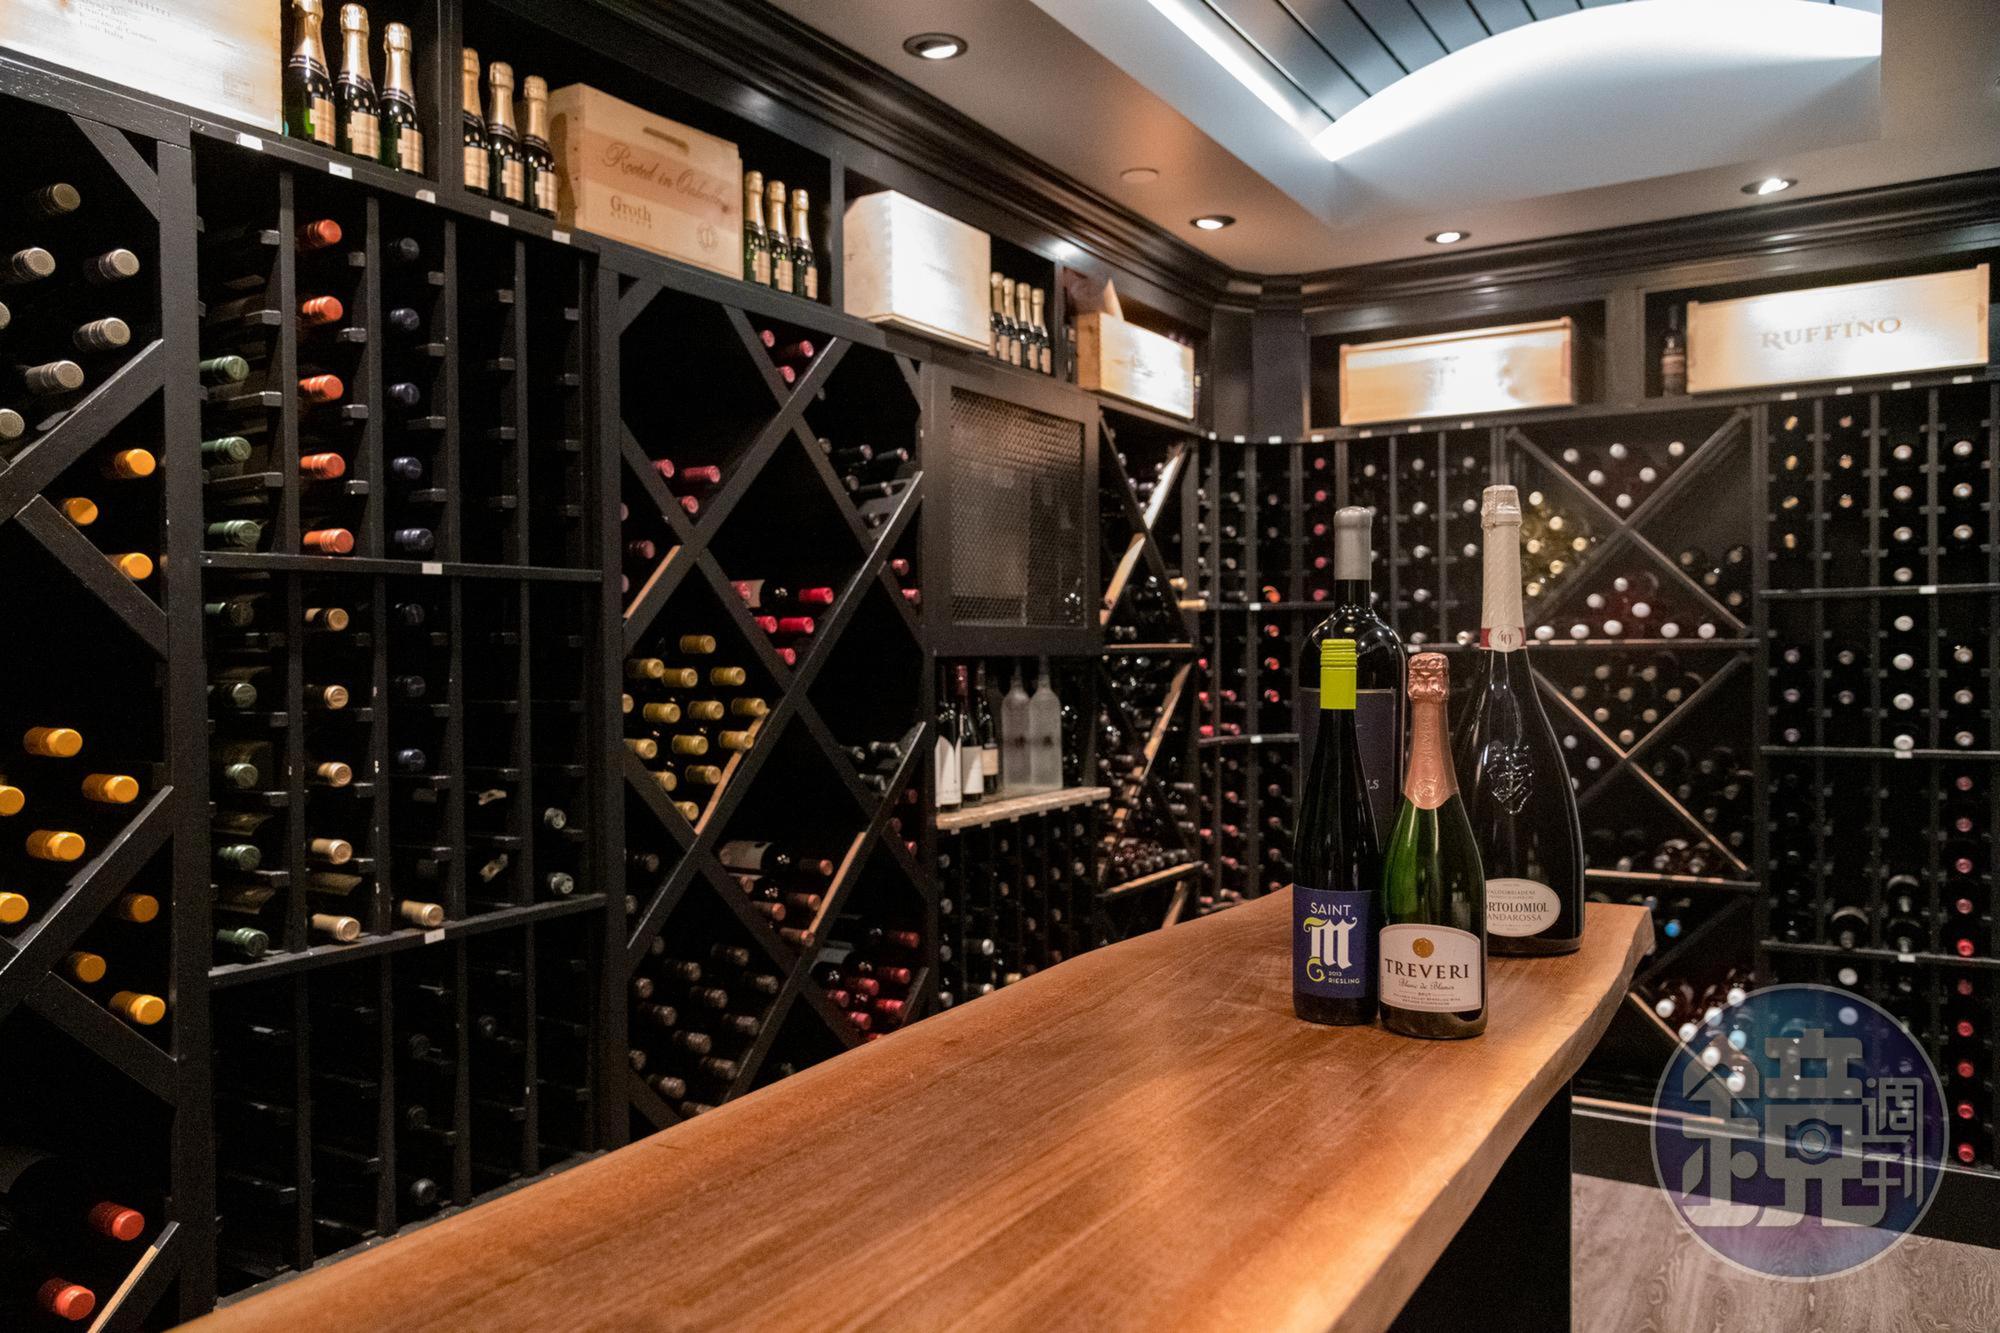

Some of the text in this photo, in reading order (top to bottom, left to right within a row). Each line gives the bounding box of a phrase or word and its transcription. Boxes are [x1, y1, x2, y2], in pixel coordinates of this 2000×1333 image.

[610, 195, 651, 222] Groth
[1760, 315, 1902, 350] RUFFINO
[1310, 902, 1351, 916] SAINT
[1487, 902, 1549, 913] RTOLOMIOL
[1487, 913, 1542, 921] ANDAROSSA
[1385, 958, 1469, 979] TREVERI
[1398, 978, 1455, 991] Blanc de Blancs
